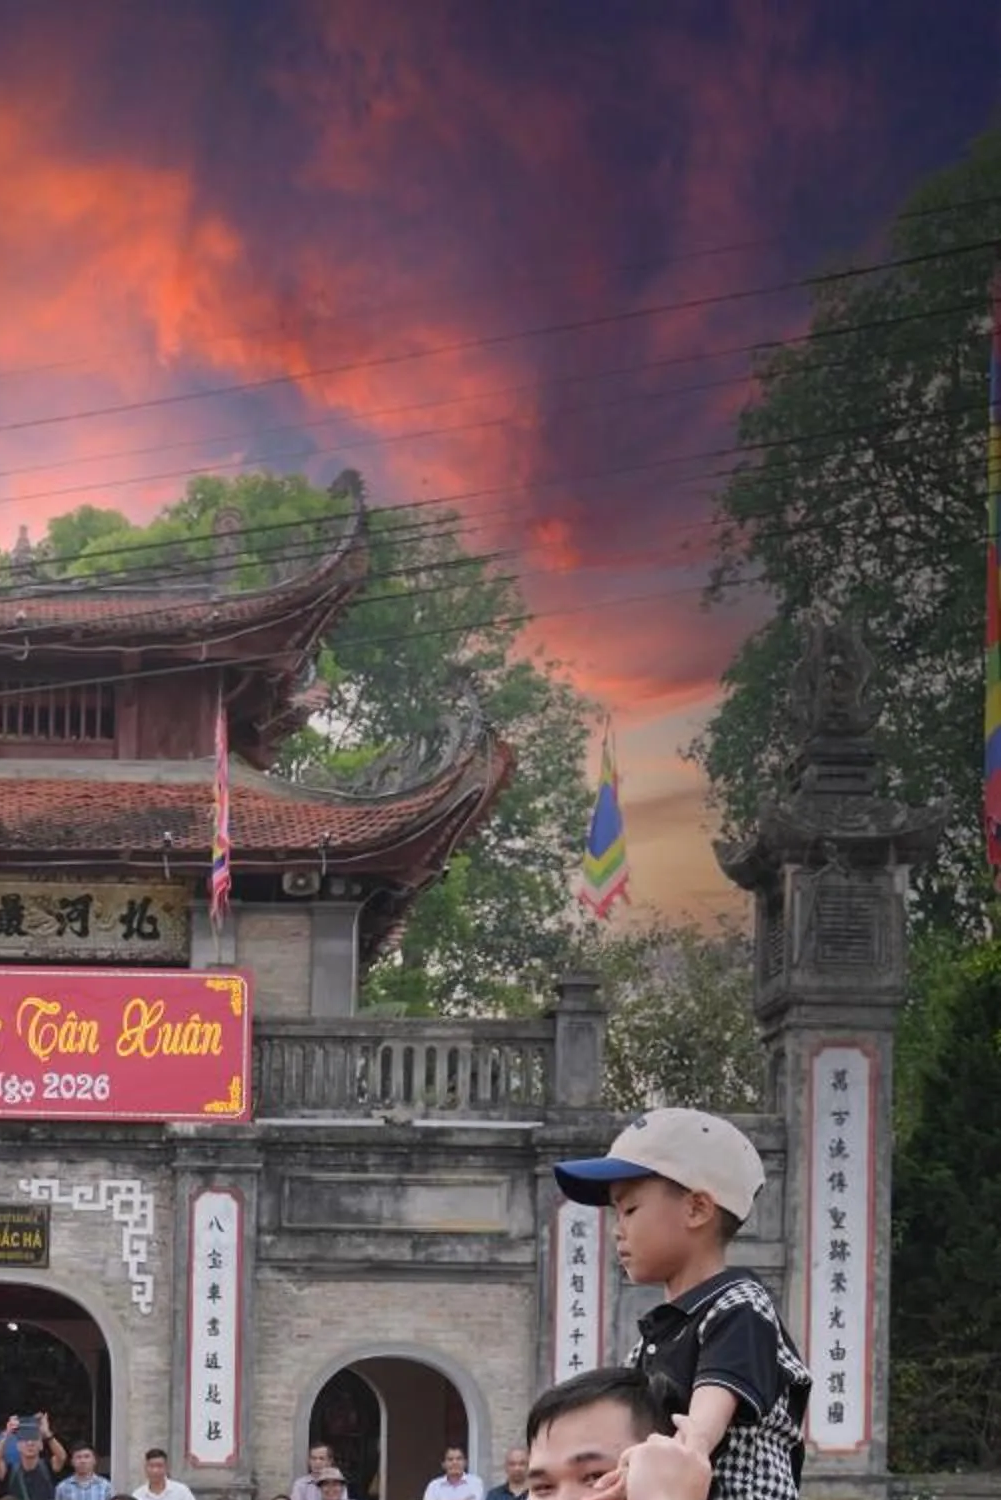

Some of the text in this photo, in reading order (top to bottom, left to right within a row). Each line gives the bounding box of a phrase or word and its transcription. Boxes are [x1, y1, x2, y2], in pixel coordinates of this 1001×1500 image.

[17, 997, 100, 1063] Tân
[116, 998, 223, 1058] Xuân
[42, 1073, 111, 1100] 2026
